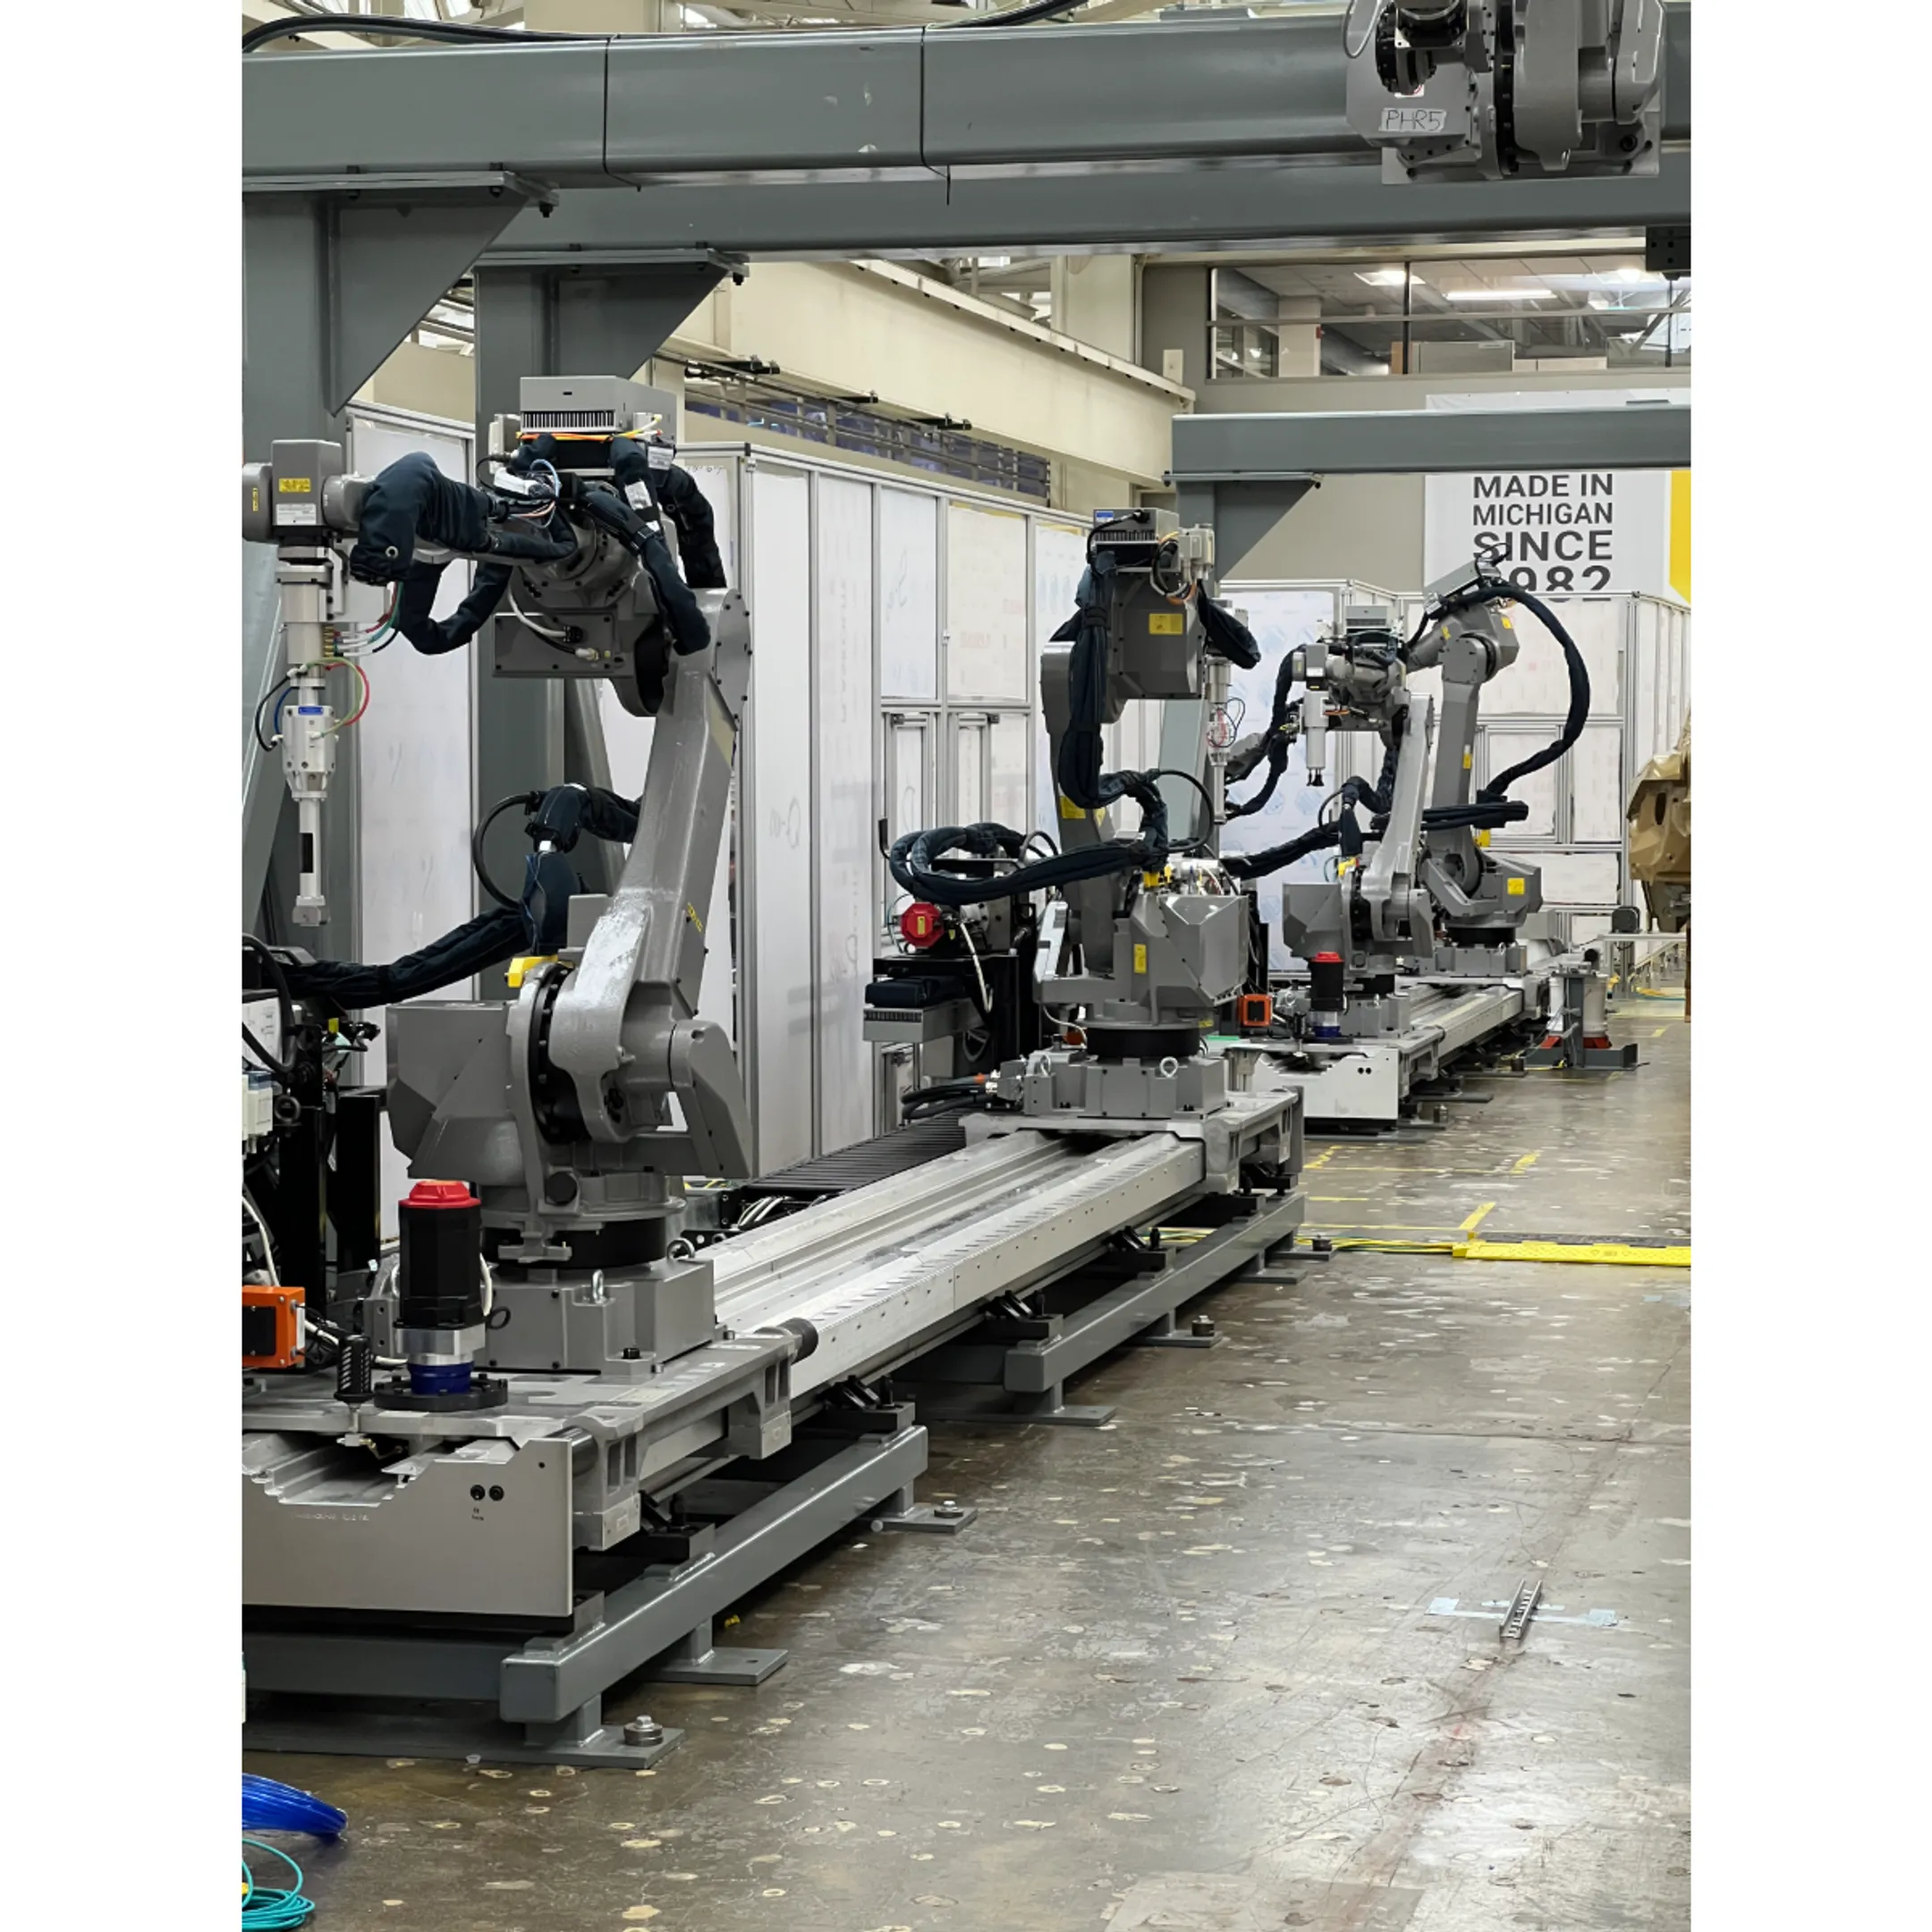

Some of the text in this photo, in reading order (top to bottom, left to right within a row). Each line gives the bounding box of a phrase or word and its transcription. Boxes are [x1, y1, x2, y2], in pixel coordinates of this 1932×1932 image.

[1386, 109, 1443, 131] PHR5
[1474, 473, 1613, 498] MADE IN
[1473, 503, 1613, 526] MICHIGAN
[1473, 530, 1613, 562] SINCE
[1508, 565, 1612, 603] 982
